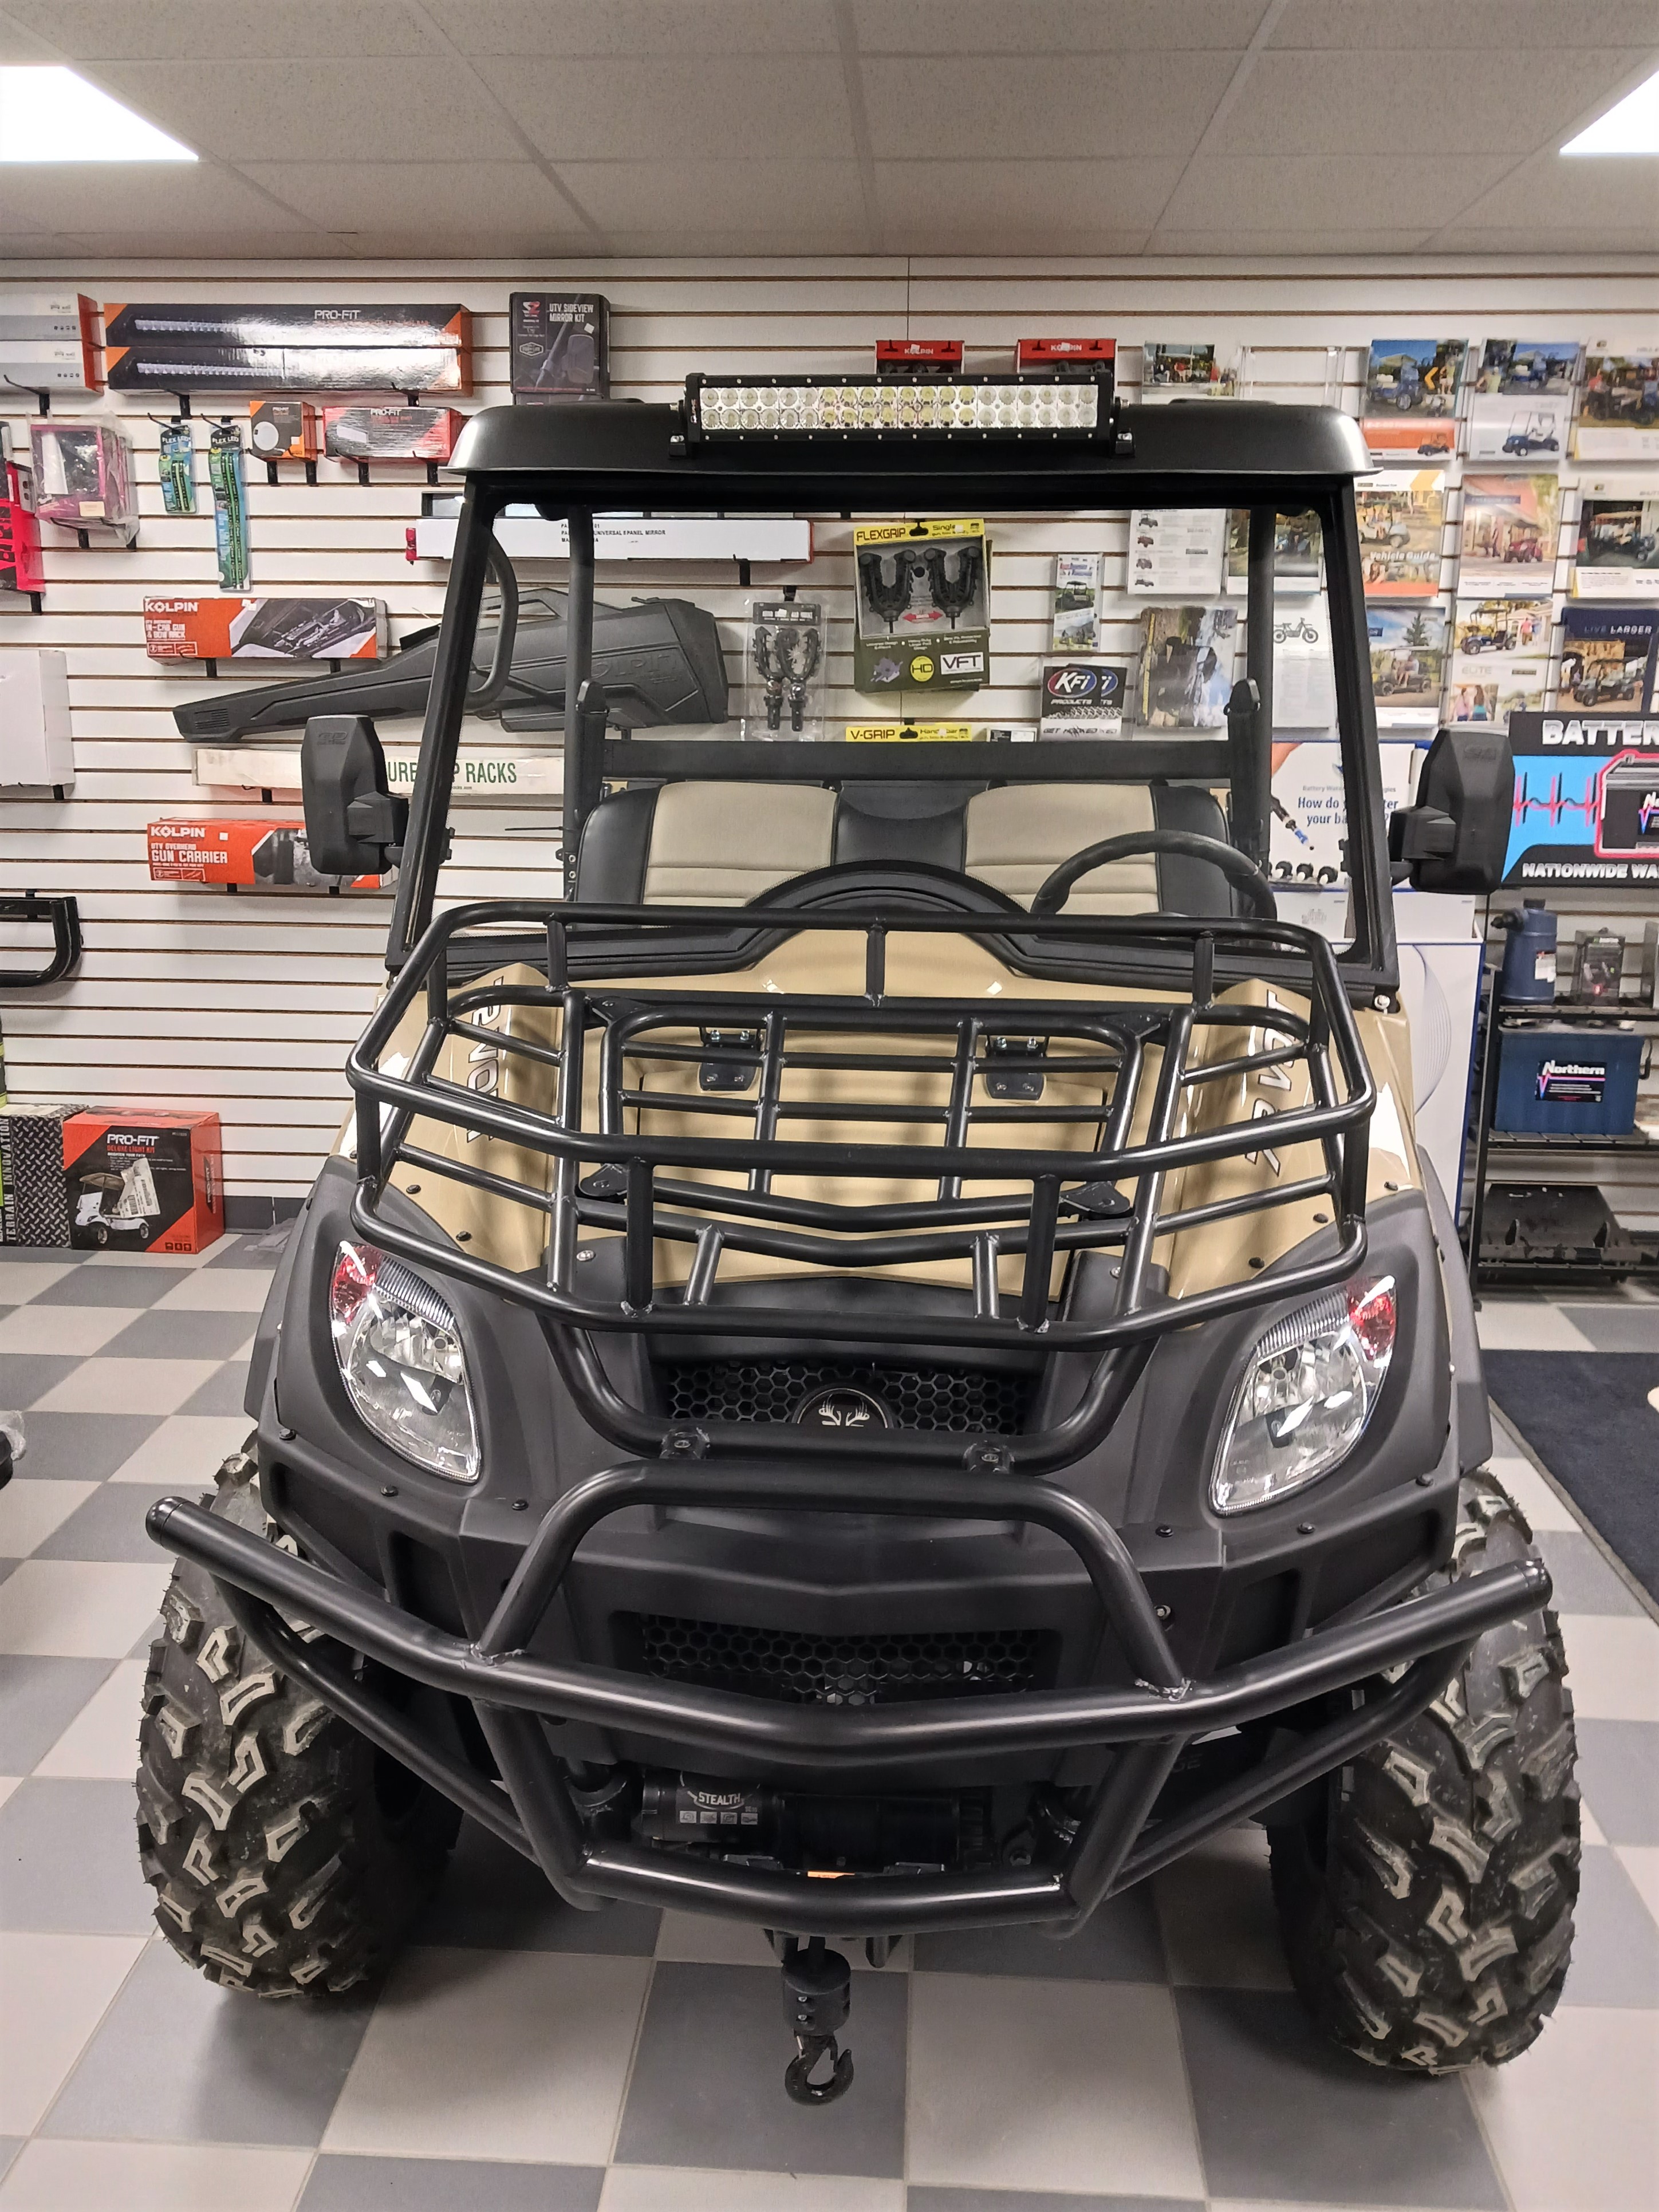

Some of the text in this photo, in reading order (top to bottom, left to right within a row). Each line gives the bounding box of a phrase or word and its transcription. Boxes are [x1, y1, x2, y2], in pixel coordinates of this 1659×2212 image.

[549, 303, 594, 313] UTV SIDEVIEW
[314, 310, 361, 320] PRO-FIT
[549, 313, 585, 322] MIRROR KIT
[856, 527, 906, 542] FLEXGRIP
[1370, 551, 1436, 560] Vehicle Guide
[145, 601, 198, 613] KOLPIN
[1610, 625, 1652, 635] LARGER
[943, 654, 981, 669] VFT
[912, 664, 933, 673] HD
[850, 729, 895, 740] V-GRIP
[466, 762, 517, 783] RACKS
[1298, 797, 1322, 809] How
[1326, 797, 1339, 809] do
[1307, 815, 1331, 827] your
[151, 825, 205, 838] KOLPIN
[151, 850, 228, 863] GUN CARRIER
[1522, 863, 1629, 878] NATIONWIDE
[1542, 1060, 1605, 1075] Northern
[107, 1134, 160, 1146] PRO-FIT
[0, 1118, 13, 1186] INNOVATION
[4, 1193, 17, 1241] TERRAIN
[698, 1791, 741, 1805] STEALTH
